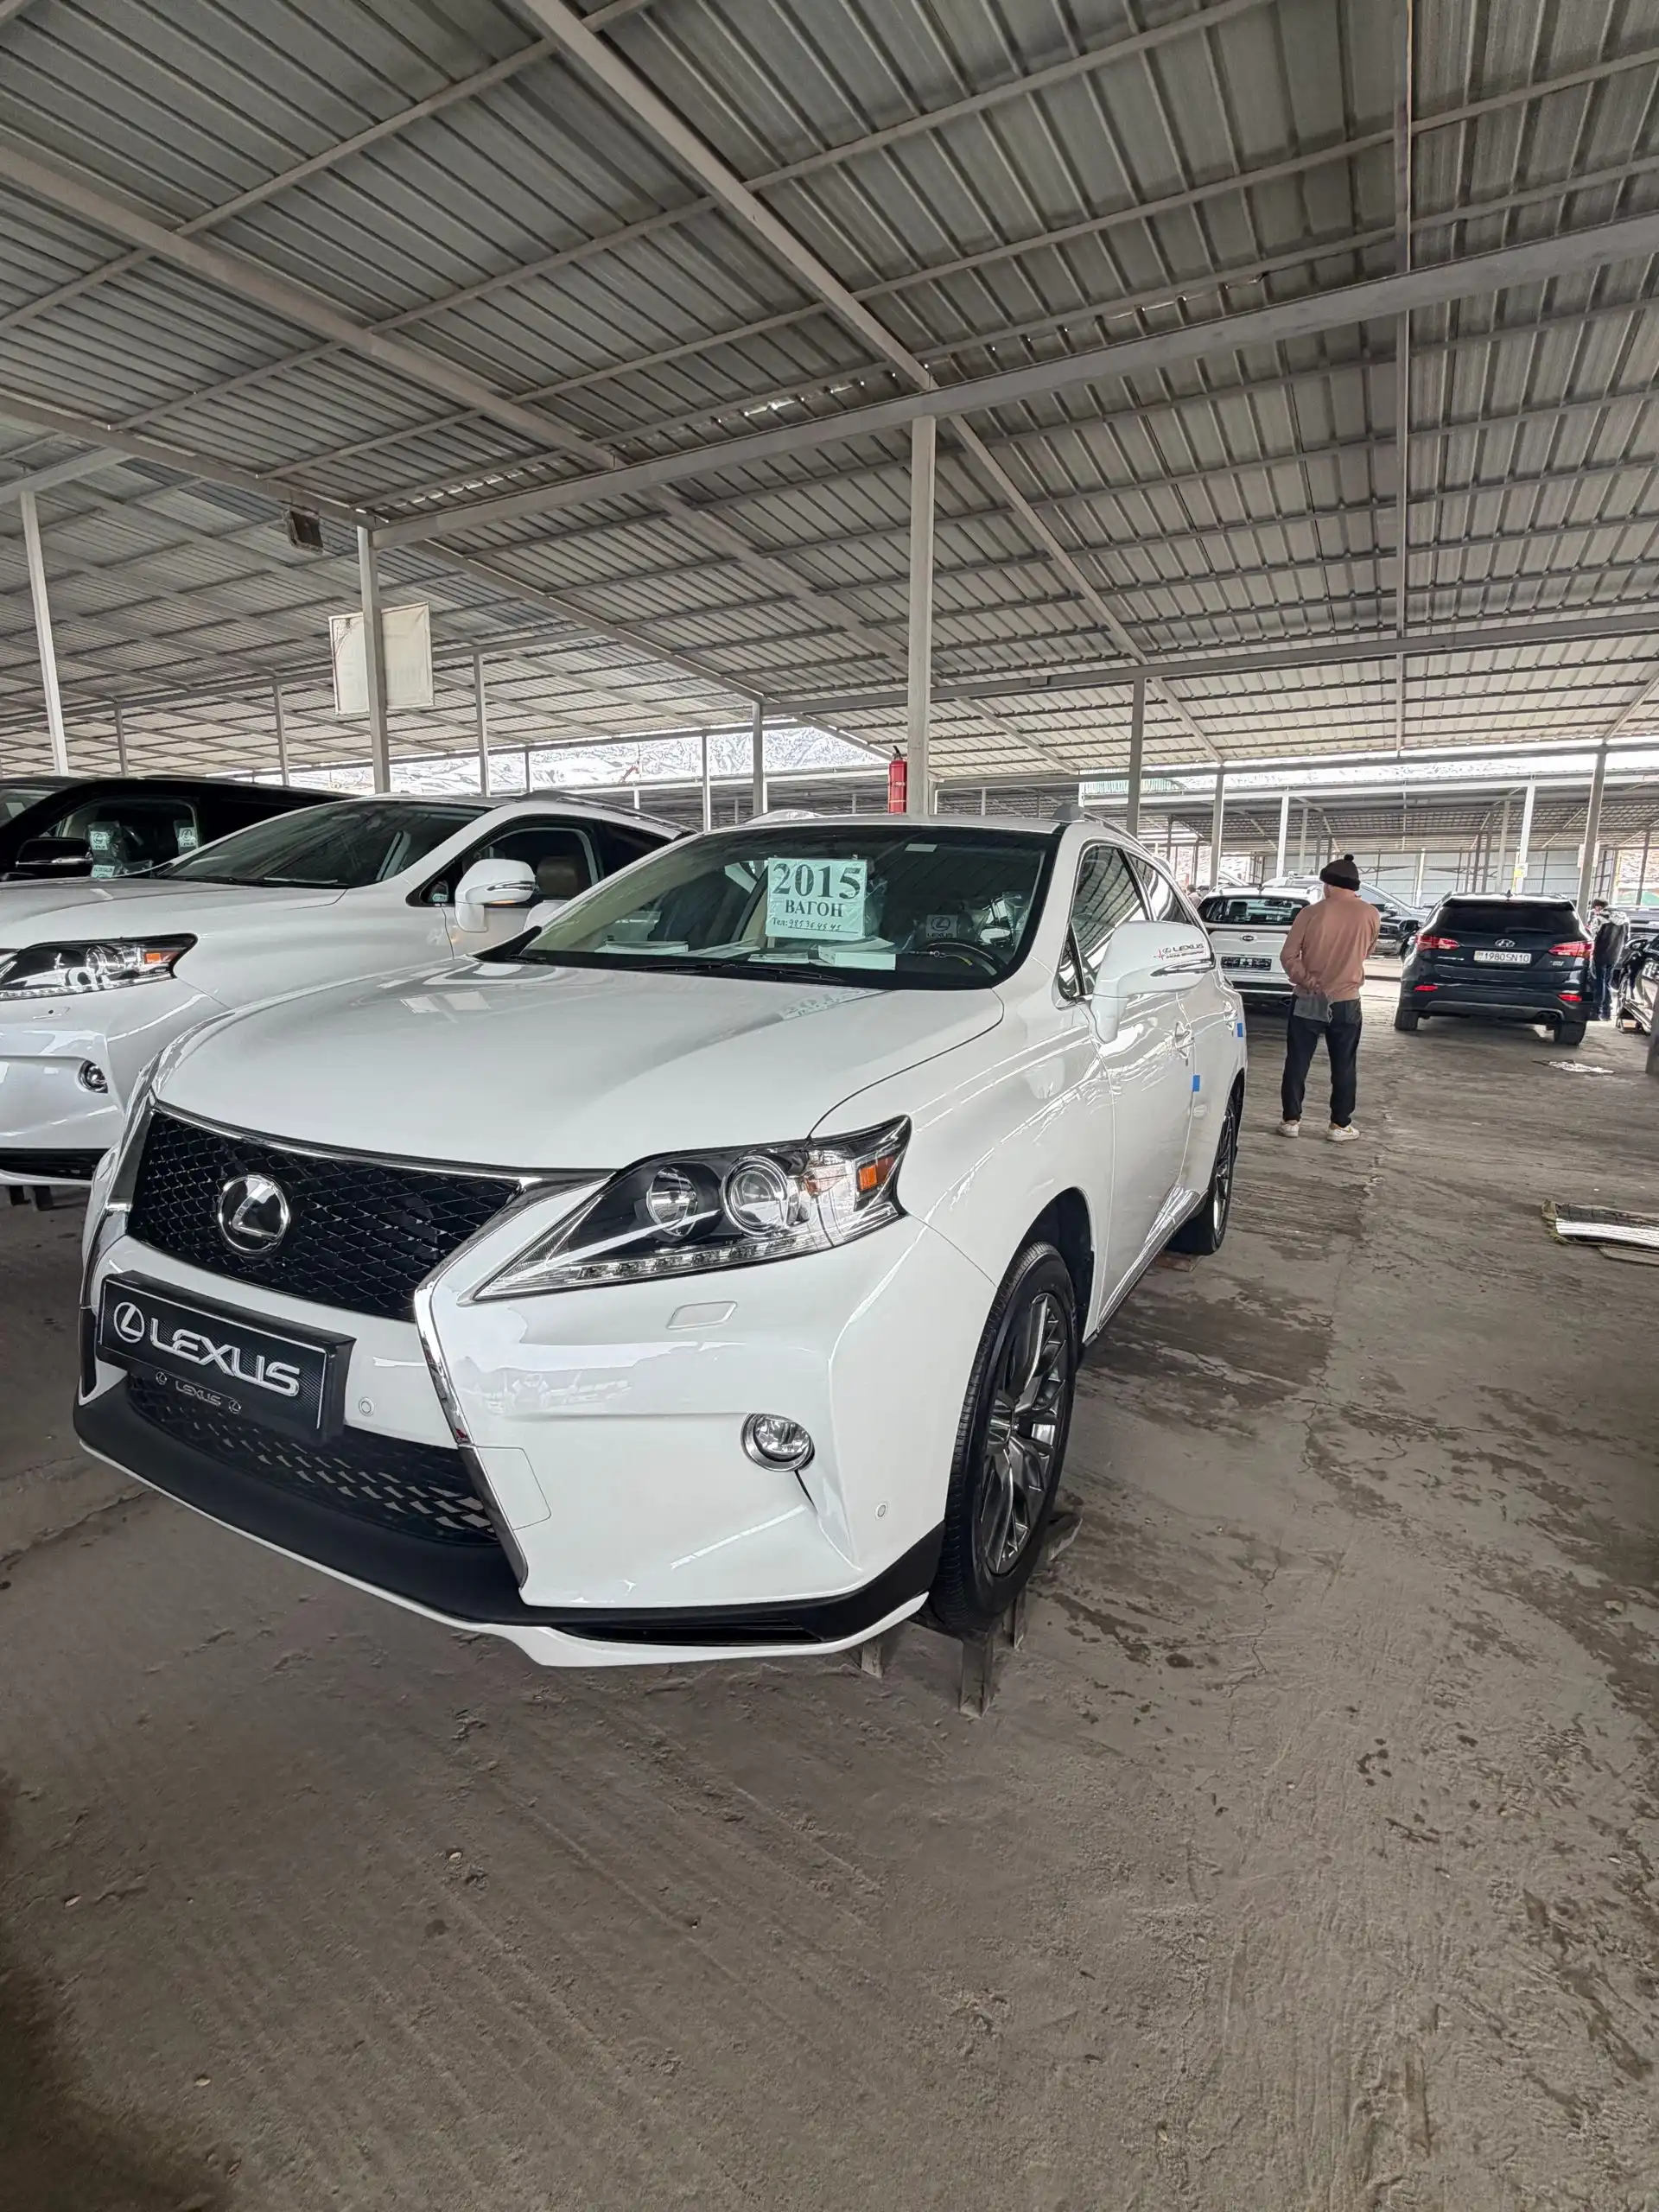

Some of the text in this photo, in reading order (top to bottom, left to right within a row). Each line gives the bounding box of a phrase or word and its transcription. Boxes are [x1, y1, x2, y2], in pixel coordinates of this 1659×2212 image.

[772, 863, 861, 899] 2015
[785, 899, 843, 918] ВАГОН
[150, 1318, 300, 1397] LEXUS
[175, 1381, 221, 1407] LEXUS
